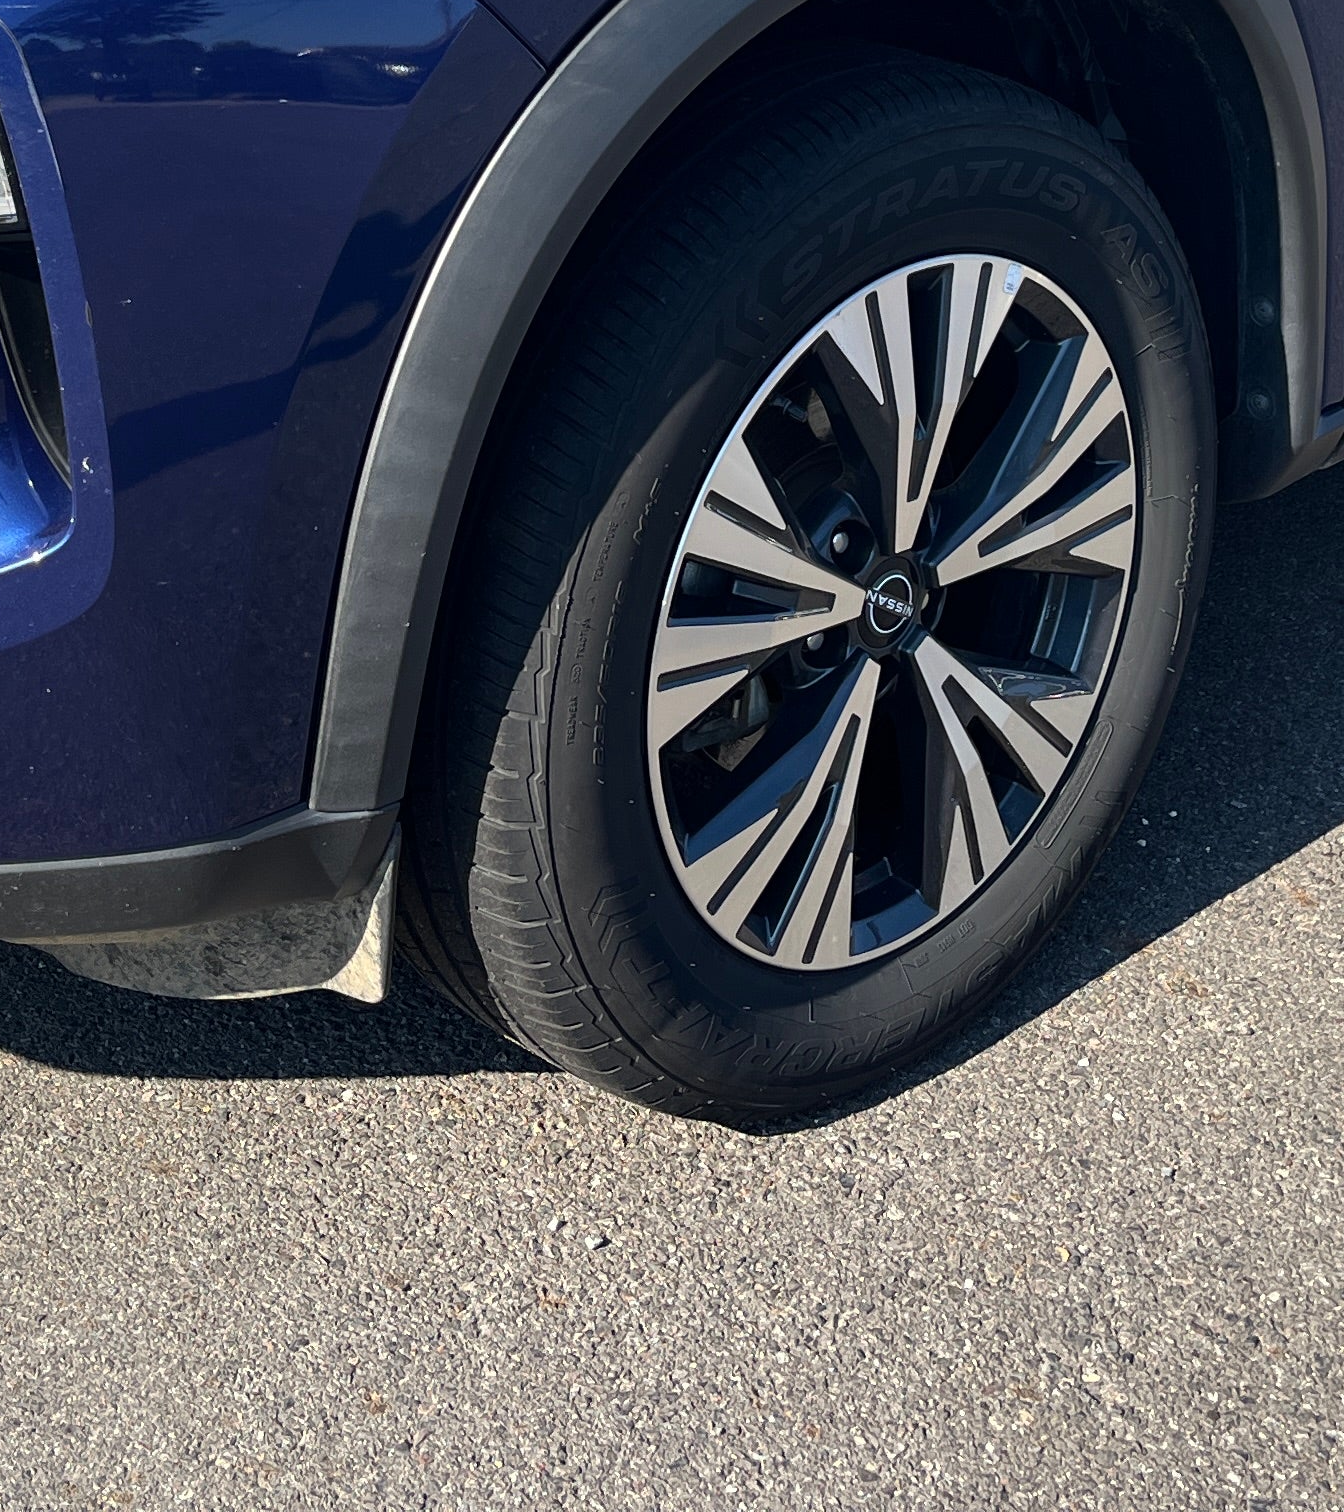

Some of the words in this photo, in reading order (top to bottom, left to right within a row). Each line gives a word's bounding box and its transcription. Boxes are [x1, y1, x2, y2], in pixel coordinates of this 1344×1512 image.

[780, 158, 1088, 305] STRATUS
[1099, 222, 1169, 299] AS
[591, 520, 619, 582] TEMPERATURE
[865, 589, 915, 618] NISSAN
